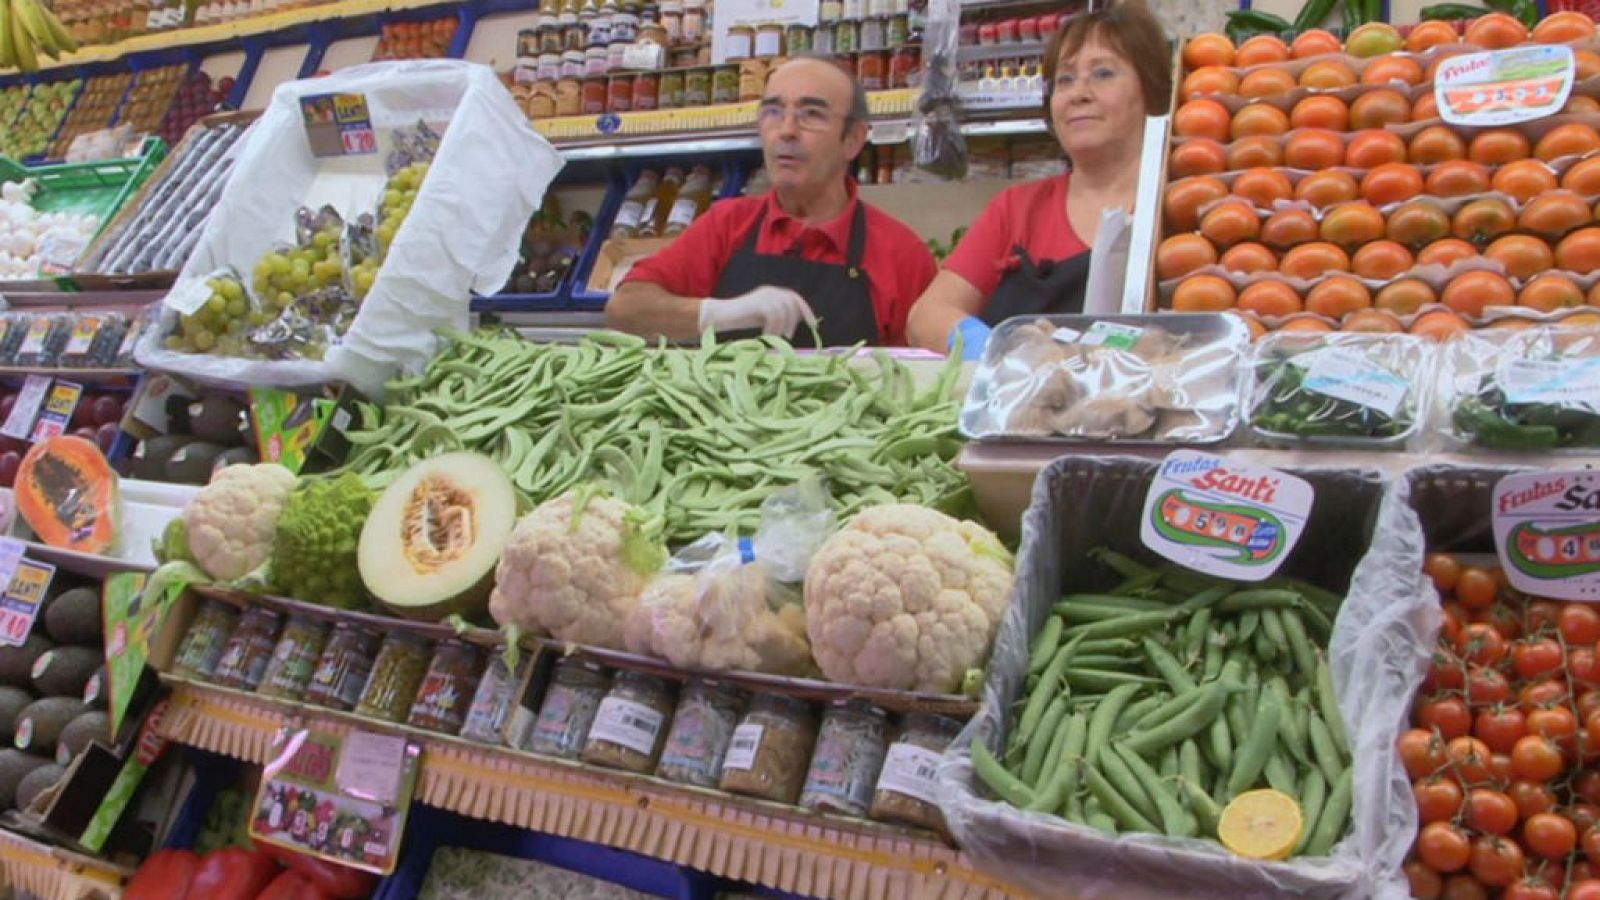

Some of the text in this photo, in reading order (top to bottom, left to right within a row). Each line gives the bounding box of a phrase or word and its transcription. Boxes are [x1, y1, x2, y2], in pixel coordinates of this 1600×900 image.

[1162, 455, 1280, 503] Frutas Santi
[1499, 478, 1566, 512] Frutas
